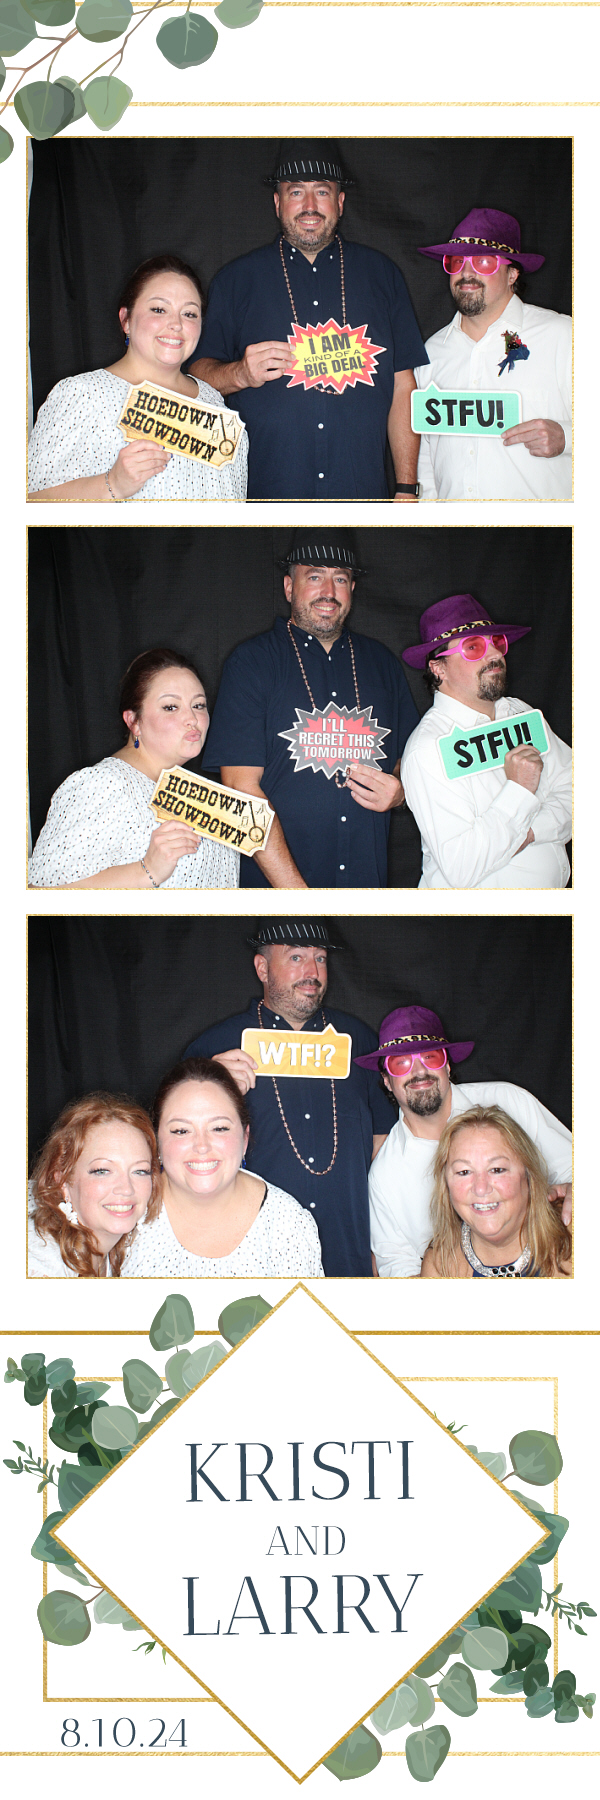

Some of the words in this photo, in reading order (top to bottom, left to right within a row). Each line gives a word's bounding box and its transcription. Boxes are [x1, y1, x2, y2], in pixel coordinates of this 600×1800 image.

[308, 338, 316, 354] I
[321, 333, 351, 353] AM
[304, 353, 332, 363] KIND
[335, 350, 350, 358] OF
[304, 360, 328, 378] BIG
[331, 356, 366, 373] DEAL
[133, 390, 218, 431] HOEDOWN
[425, 398, 505, 429] STFU!
[121, 408, 218, 462] SHOWDOWN
[322, 718, 347, 733] I'LL
[299, 732, 344, 746] REGRET
[347, 734, 375, 747] THIS
[303, 746, 372, 760] TOMORROW
[165, 774, 247, 817] HOEDOWN
[152, 790, 247, 847] SHOWDOWN
[258, 1041, 336, 1068] WTF!?
